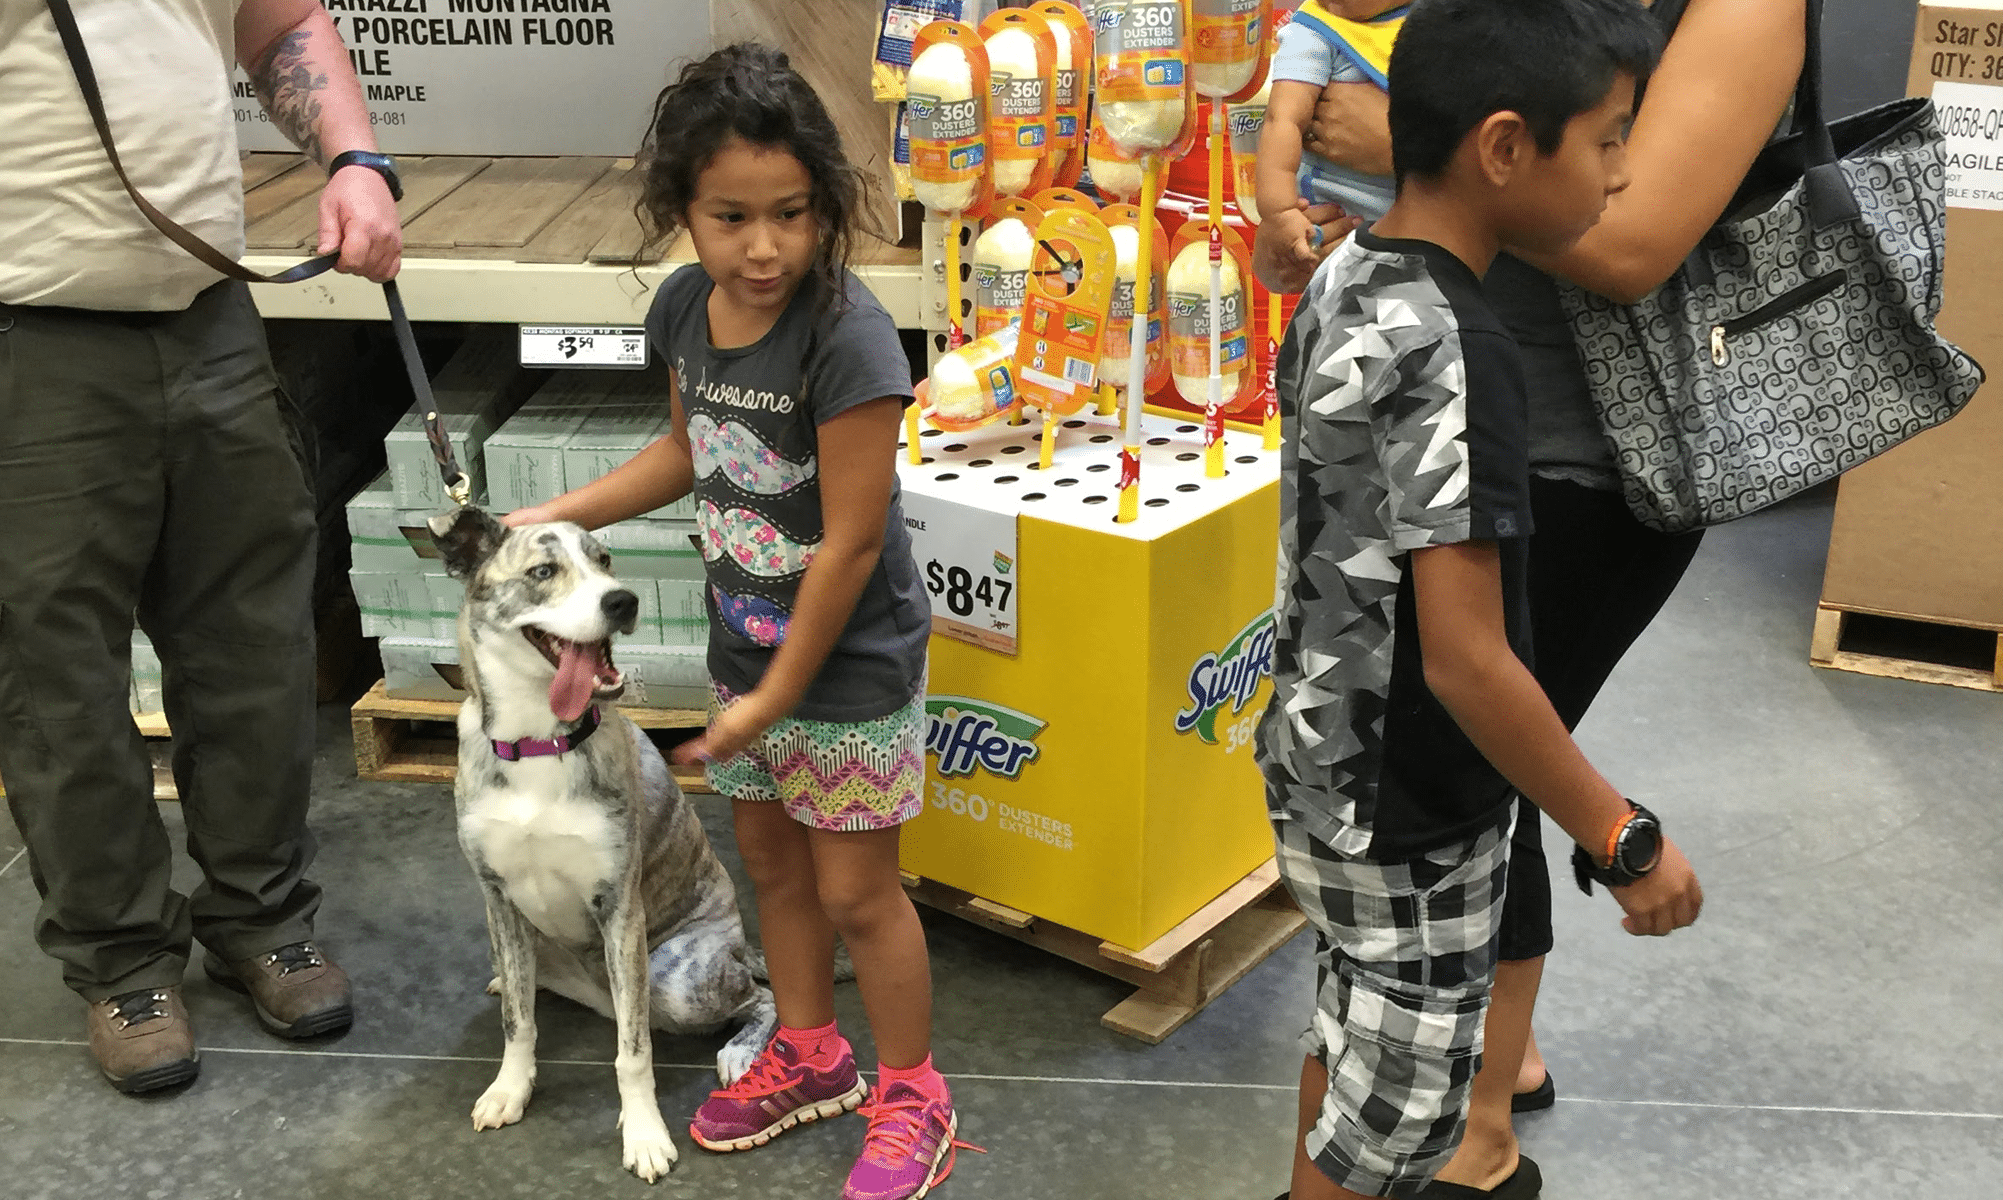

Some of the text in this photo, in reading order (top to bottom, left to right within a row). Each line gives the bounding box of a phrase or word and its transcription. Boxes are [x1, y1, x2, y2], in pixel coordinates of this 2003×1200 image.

[352, 16, 512, 46] PORCELAIN
[522, 18, 615, 46] FLOOR
[1123, 26, 1174, 39] DUSTERS
[1124, 37, 1176, 48] EXTENDER
[1935, 19, 1980, 46] Star
[1931, 51, 1976, 78] QTY:
[367, 84, 427, 102] MAPLE
[1002, 97, 1041, 107] DUSTERS
[932, 117, 976, 131] DUSTERS
[696, 366, 795, 414] Awesome
[998, 802, 1073, 838] DUSTERS
[998, 817, 1074, 851] EXTENDER
